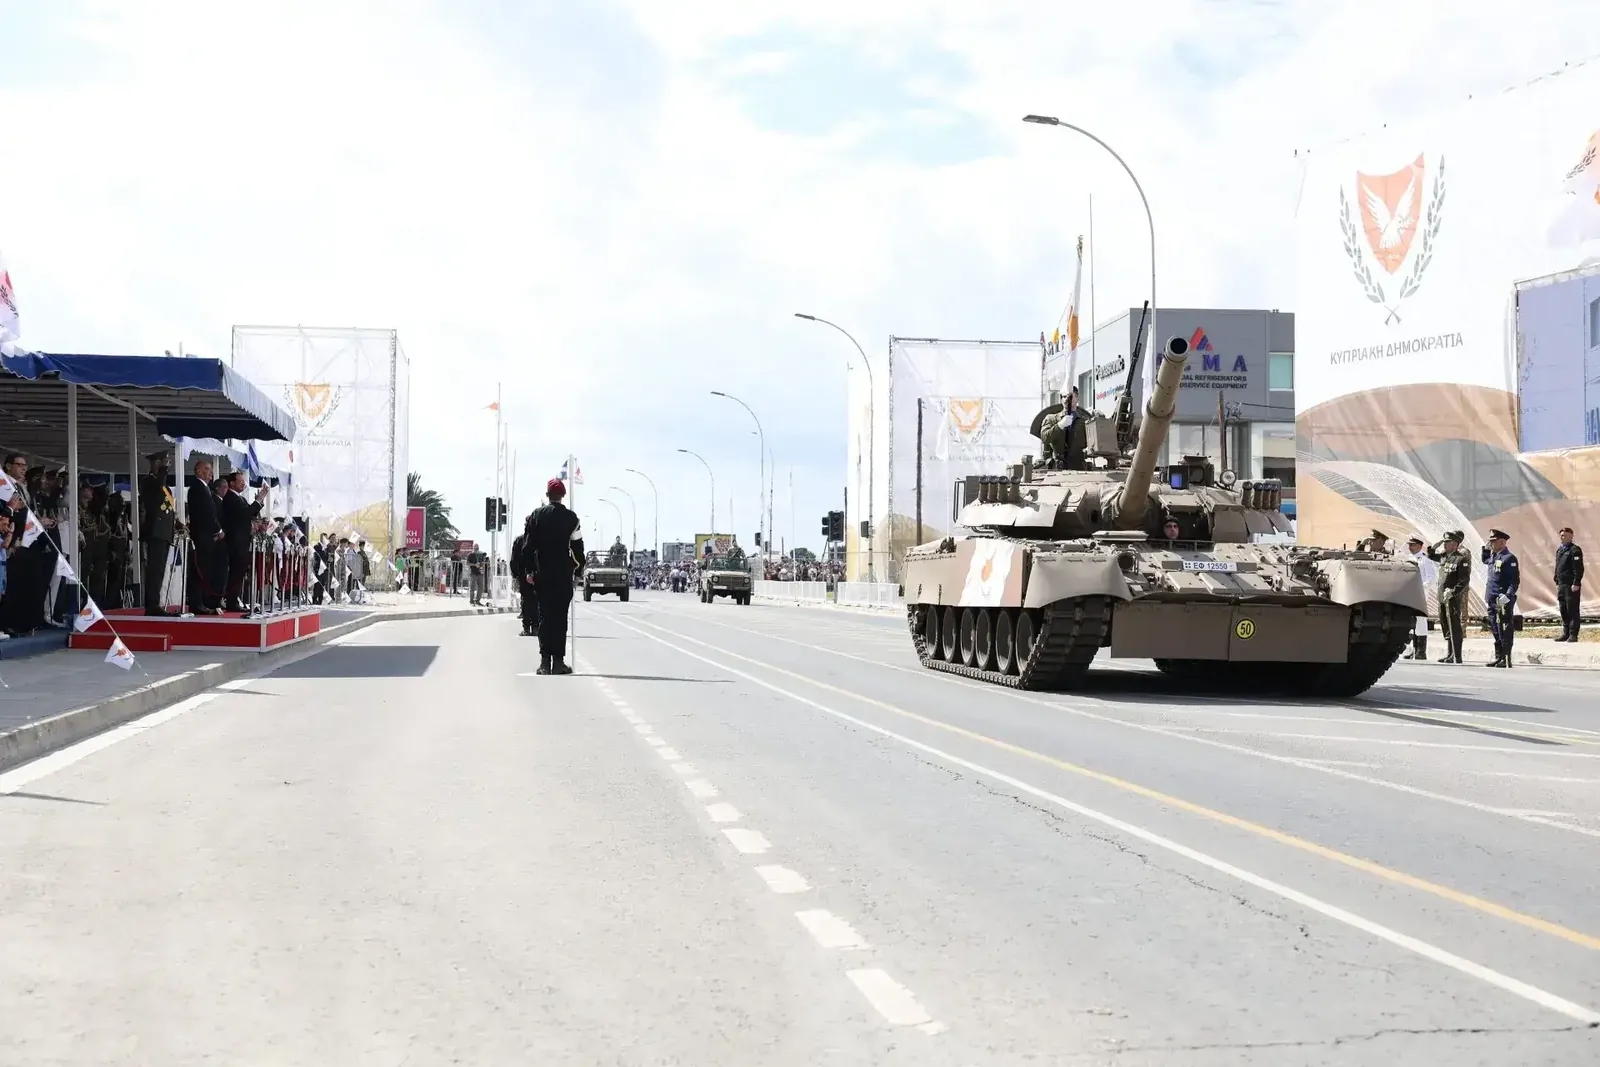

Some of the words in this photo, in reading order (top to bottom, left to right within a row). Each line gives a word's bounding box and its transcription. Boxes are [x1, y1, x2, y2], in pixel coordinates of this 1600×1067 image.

[1330, 345, 1384, 365] ΚΥΠΡΙΑΚΗ
[1386, 332, 1464, 357] ΔΗΜΟΚΡΑΤΙΑ
[1194, 374, 1247, 382] REFRIGERATORS
[1207, 562, 1228, 570] 12550
[1240, 623, 1252, 636] 50
